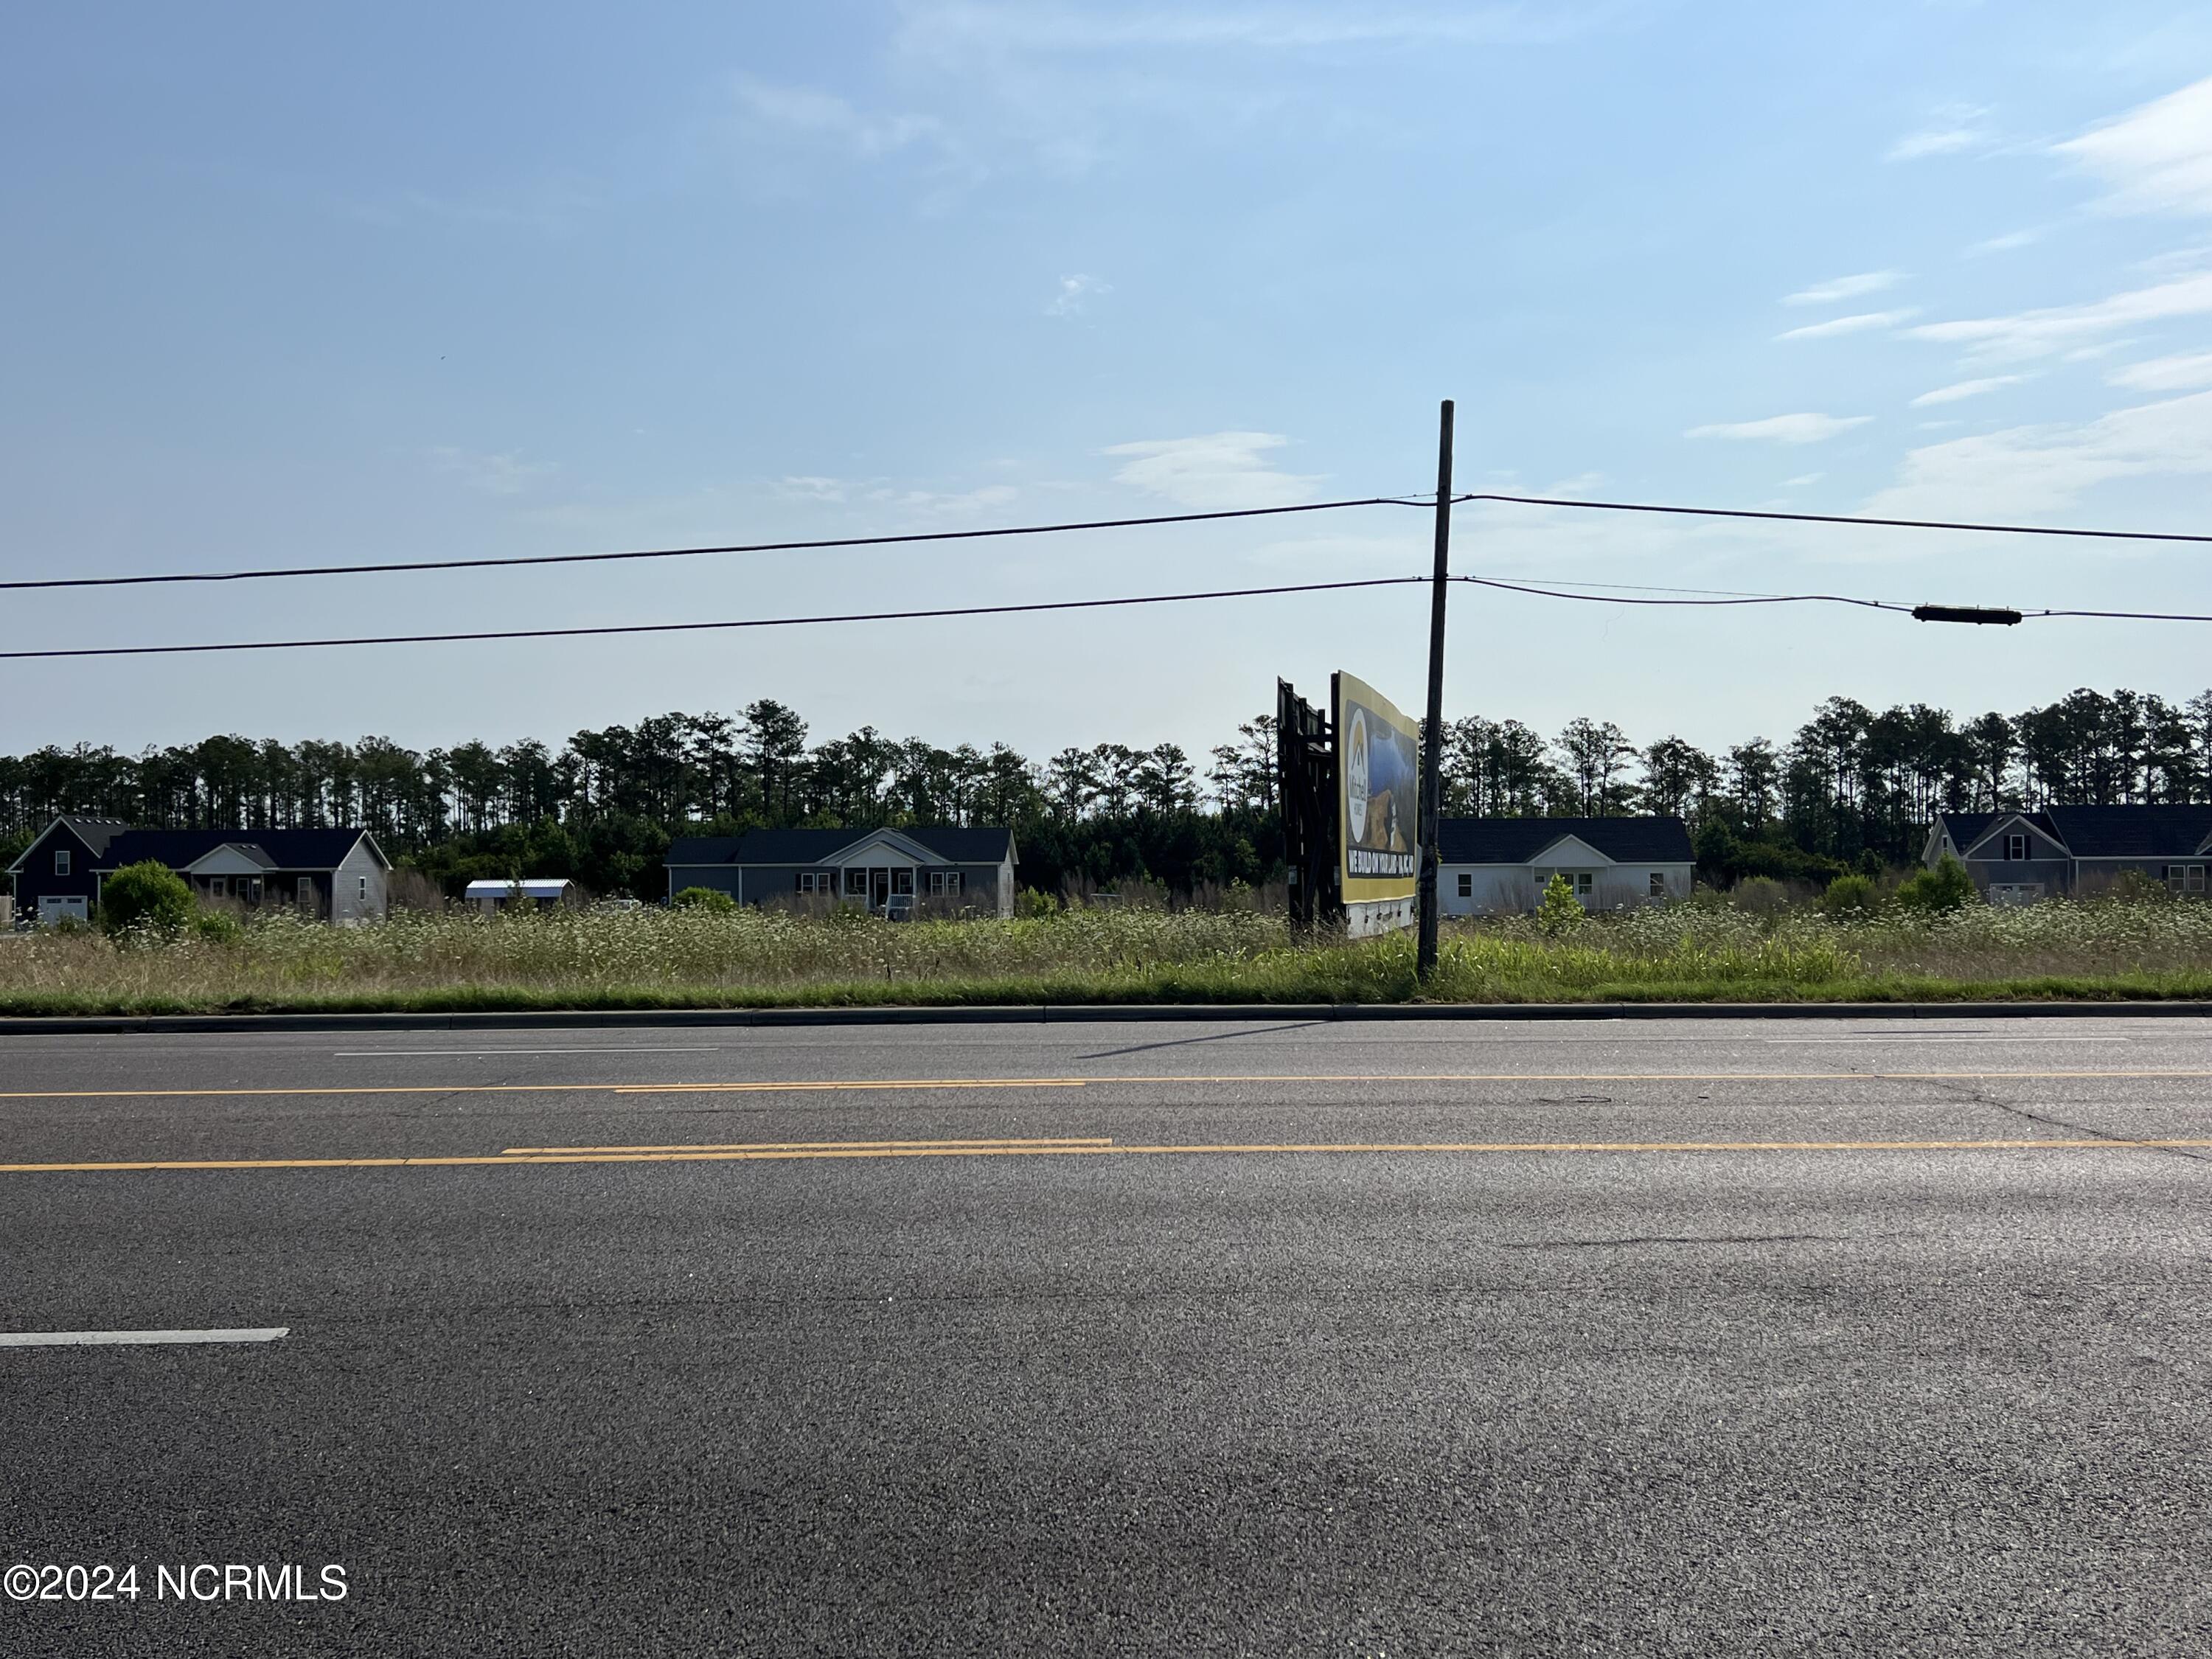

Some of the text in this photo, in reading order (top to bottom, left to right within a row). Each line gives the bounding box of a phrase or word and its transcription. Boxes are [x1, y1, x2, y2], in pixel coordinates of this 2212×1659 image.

[1349, 773, 1366, 801] Mitchell
[1348, 849, 1357, 873] WE
[1357, 850, 1371, 874] BUILD
[1371, 852, 1379, 874] ON
